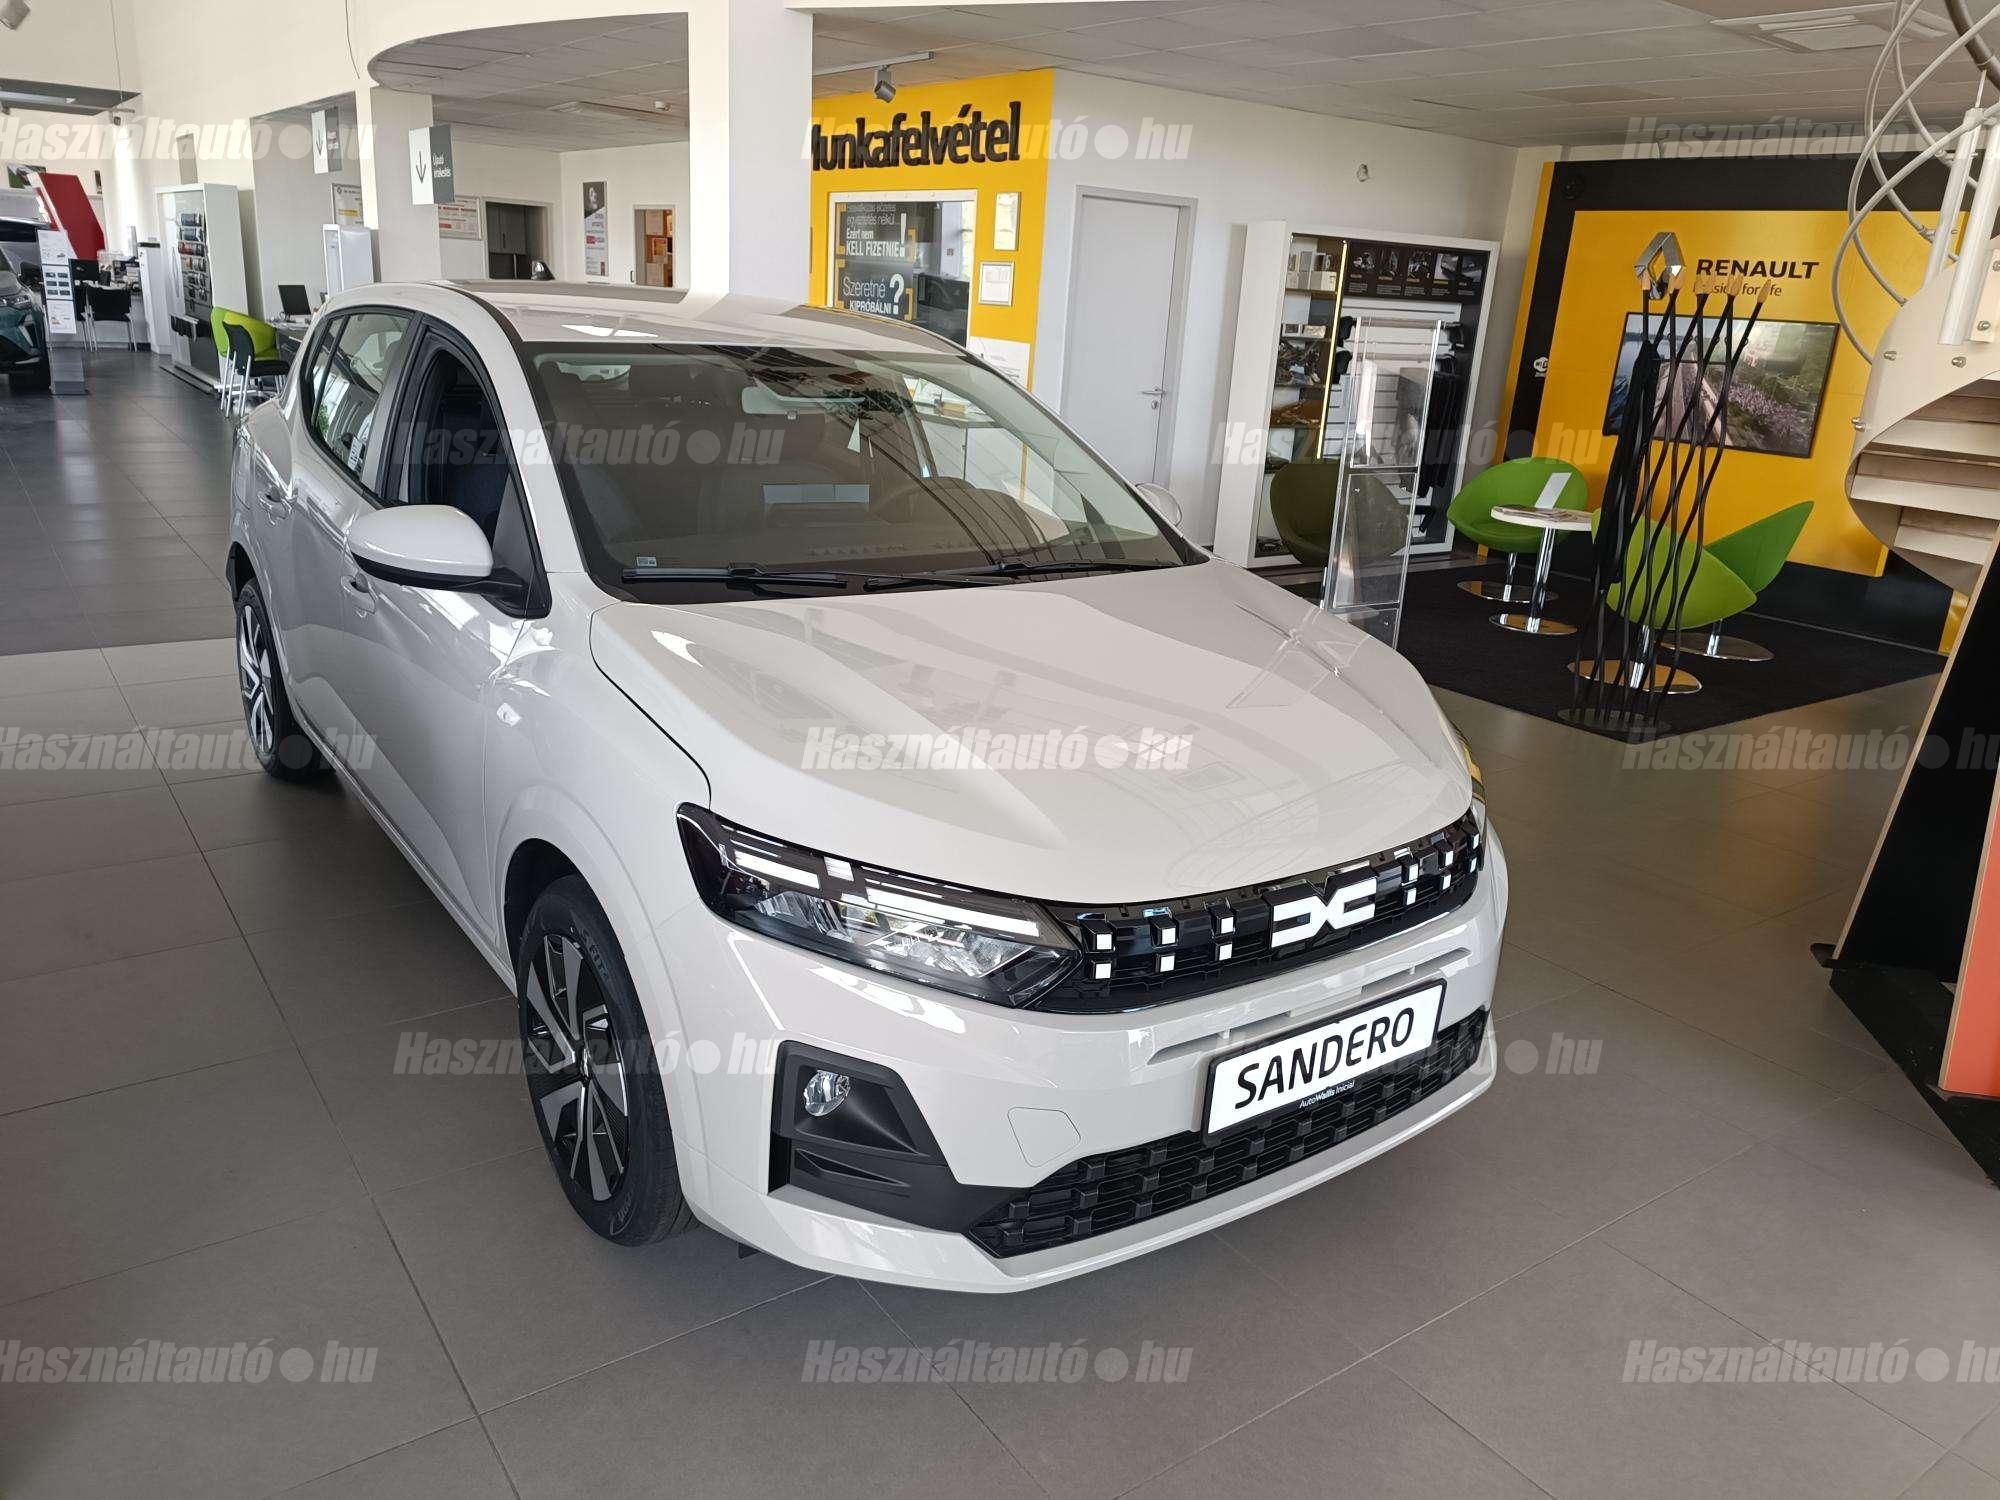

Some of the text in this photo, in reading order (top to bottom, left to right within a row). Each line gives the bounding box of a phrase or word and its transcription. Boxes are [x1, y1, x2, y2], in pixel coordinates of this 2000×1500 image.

[846, 240, 863, 257] KELL
[865, 240, 900, 257] FIZETNIE
[1695, 258, 1820, 279] RENAULT
[842, 275, 886, 298] Szeretné
[1741, 282, 1760, 296] for
[1235, 1007, 1414, 1109] SANDERO
